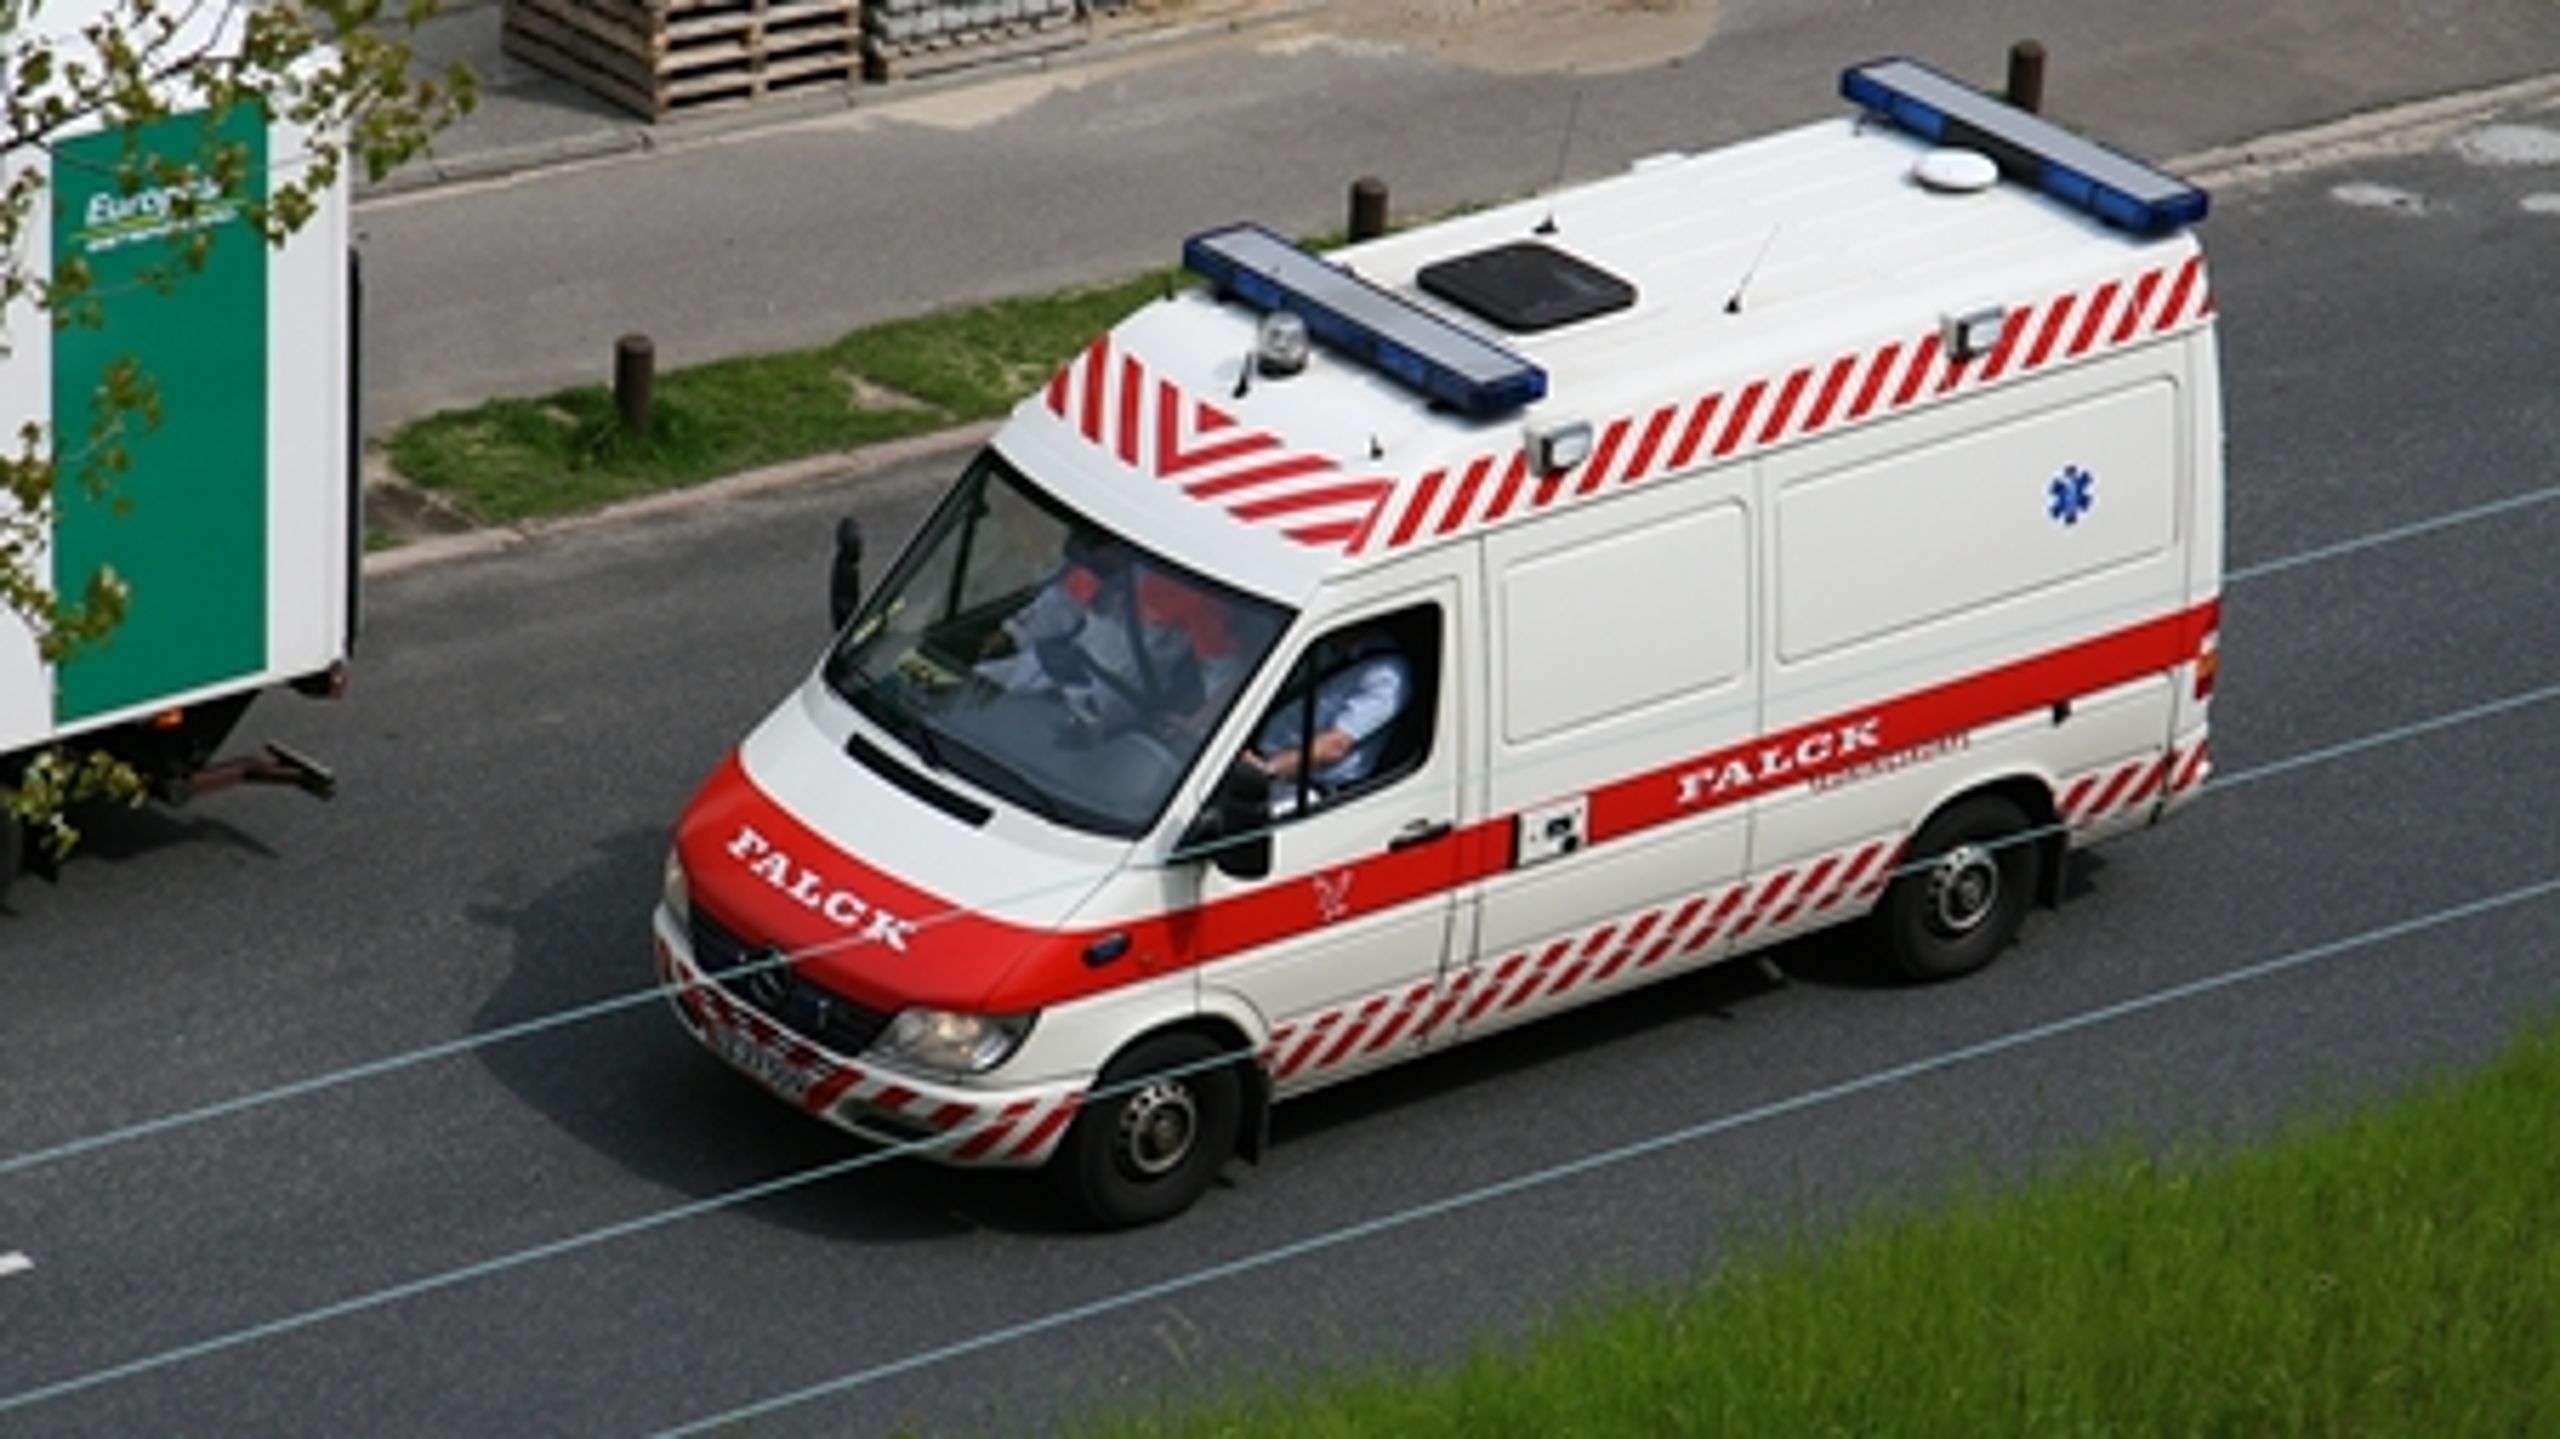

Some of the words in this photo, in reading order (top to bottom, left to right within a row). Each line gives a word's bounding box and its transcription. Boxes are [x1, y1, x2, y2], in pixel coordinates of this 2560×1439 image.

[85, 174, 224, 227] Europ
[1677, 715, 1882, 803] FALCK
[726, 826, 917, 952] FALCK
